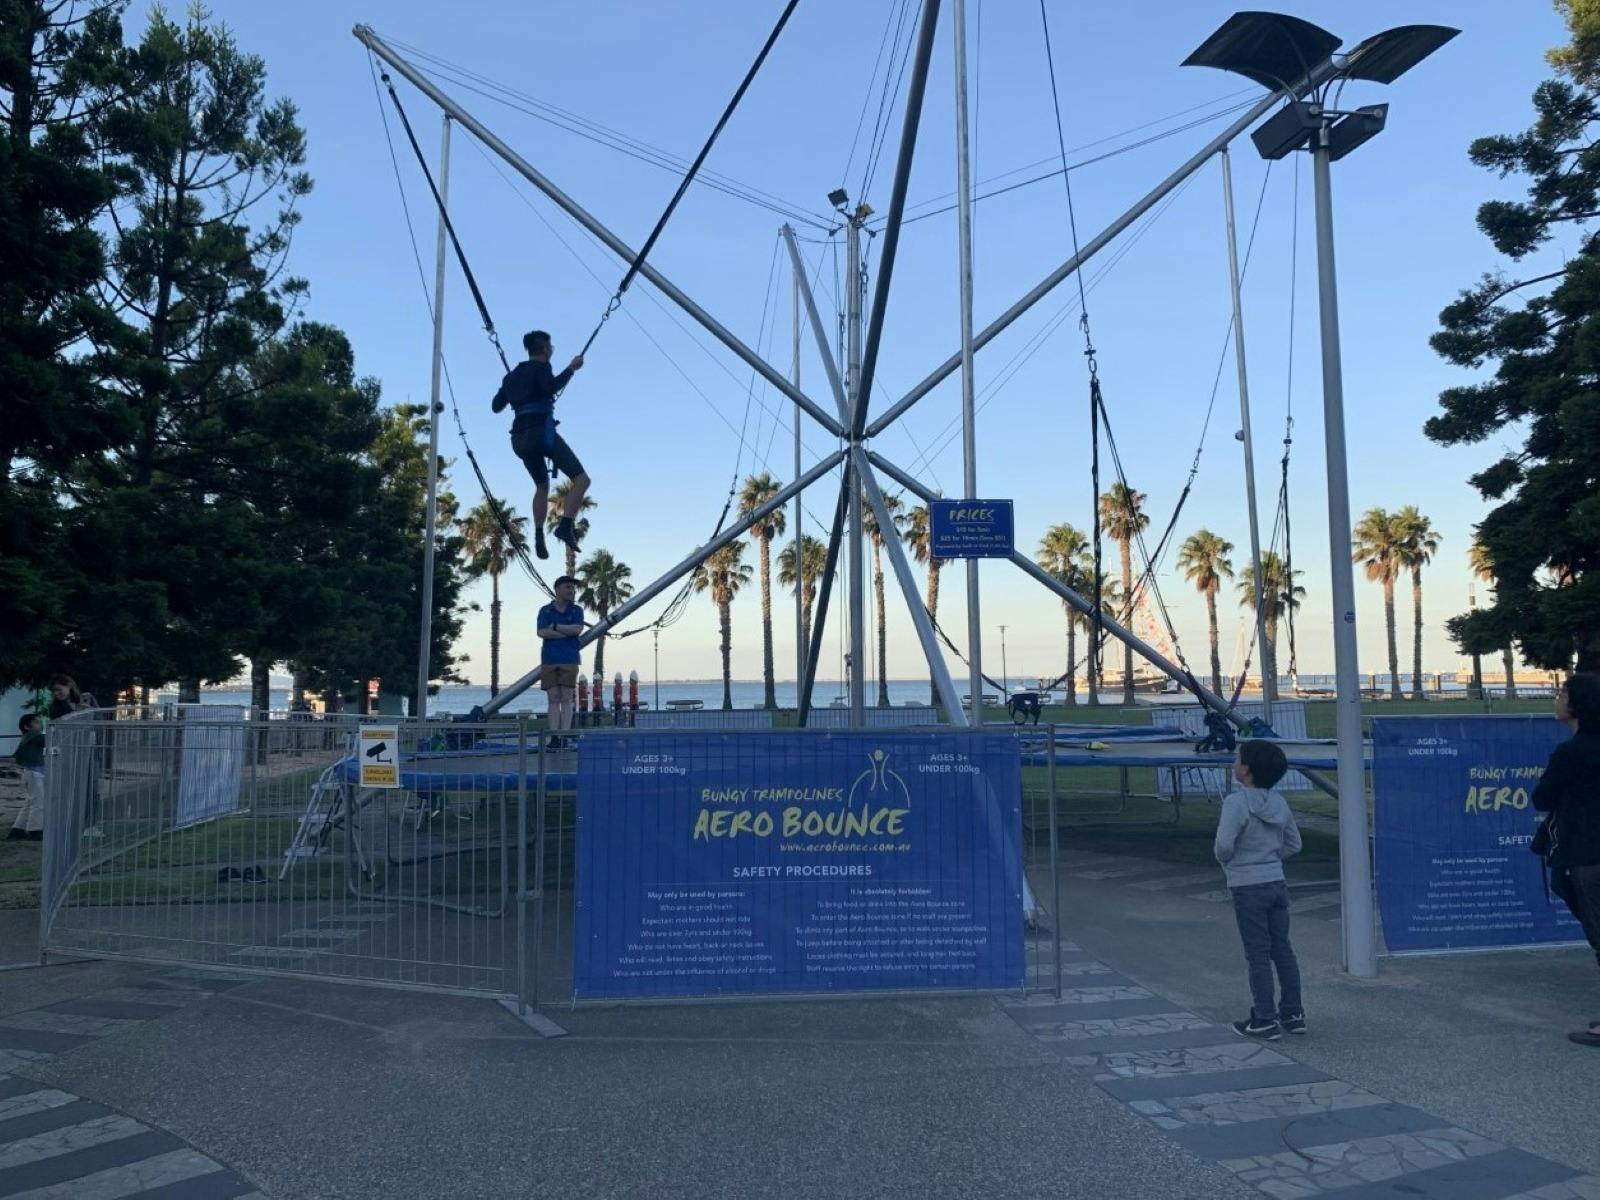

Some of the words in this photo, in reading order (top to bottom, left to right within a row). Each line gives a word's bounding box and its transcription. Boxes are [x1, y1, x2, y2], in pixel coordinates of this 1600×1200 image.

[949, 508, 995, 521] PRICES
[930, 754, 955, 762] AGES
[1408, 748, 1435, 756] UNDER
[633, 755, 660, 763] AGES
[661, 755, 674, 763] 3+
[621, 766, 657, 774] UNDER
[659, 766, 686, 776] 100kg
[919, 764, 952, 773] UNDER
[954, 765, 981, 775] 100kg
[1469, 767, 1508, 781] BUNGY
[701, 788, 750, 804] BUNGY
[751, 787, 844, 802] TRAMPOLINES
[1464, 785, 1529, 816] AERO
[693, 808, 774, 842] AERO
[782, 803, 911, 839] BOUNCE
[779, 840, 911, 853] www.aerobounce.com.au
[1498, 835, 1536, 846] SAFETY
[732, 866, 781, 878] SAFETY
[785, 865, 872, 877] PROCEDURES
[648, 891, 662, 900] May
[690, 890, 706, 898] used
[708, 890, 717, 900] by
